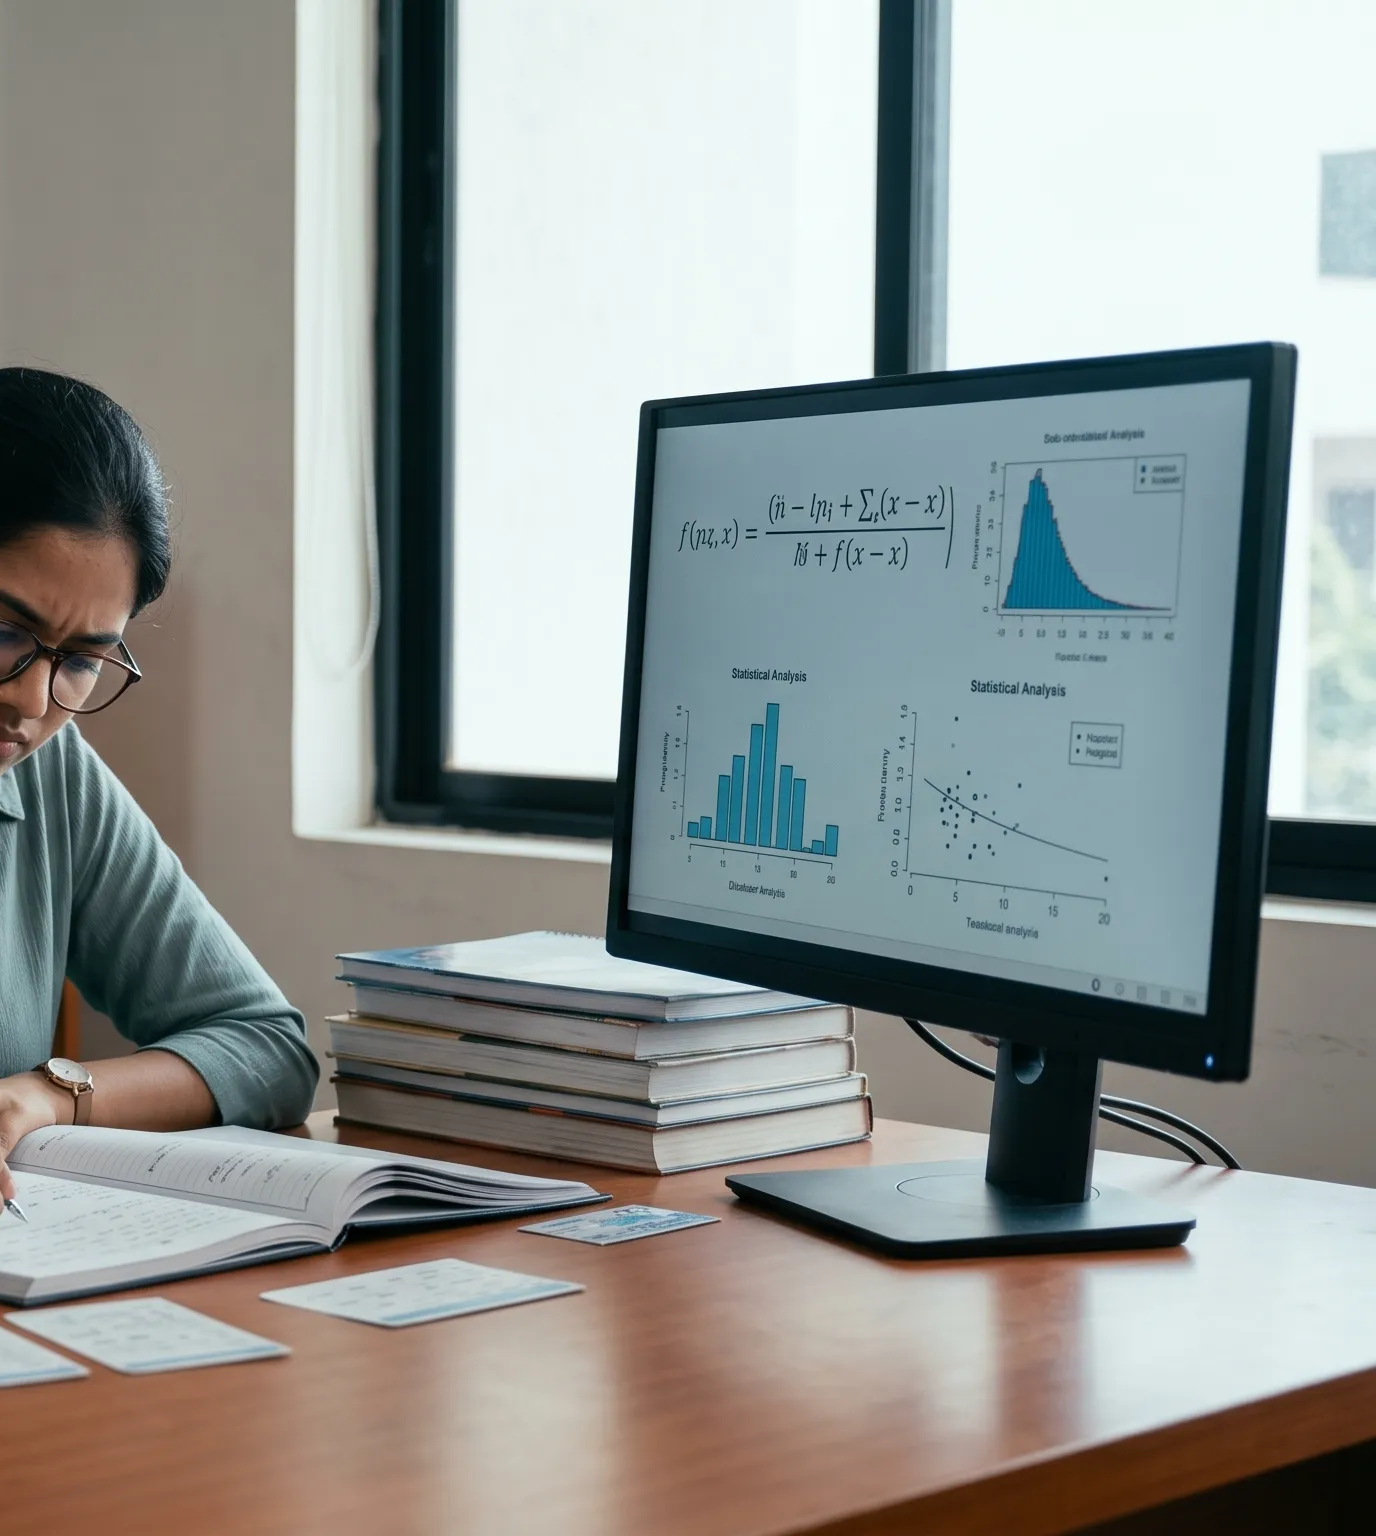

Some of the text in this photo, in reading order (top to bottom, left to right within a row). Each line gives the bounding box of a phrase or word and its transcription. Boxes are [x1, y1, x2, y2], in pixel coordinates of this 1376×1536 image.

[732, 667, 807, 684] Statistical Analysis
[970, 679, 1066, 699] Statistical Analysis
[907, 885, 1110, 926] 0 5 10 15 20
